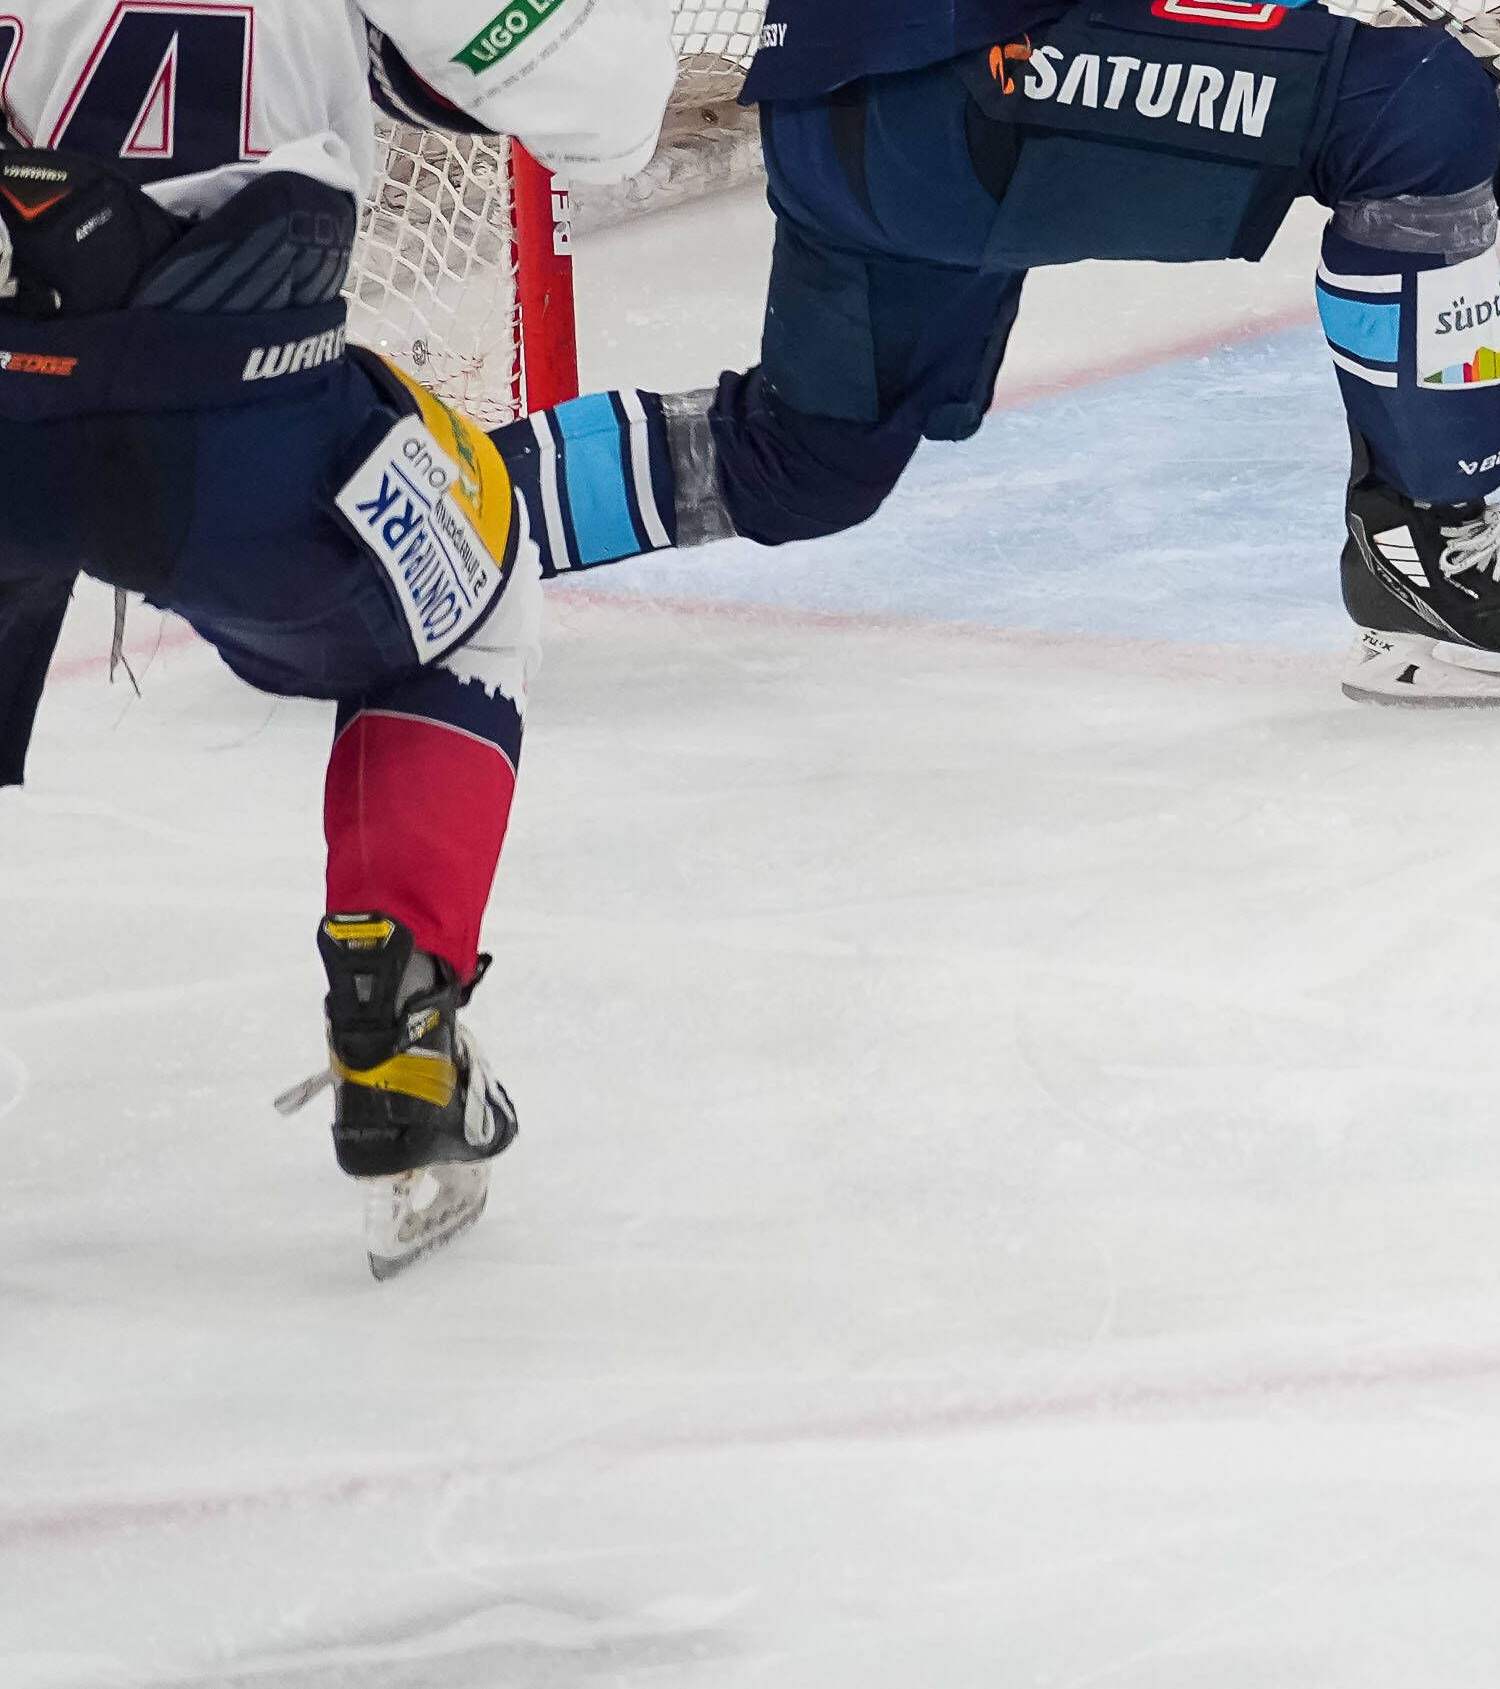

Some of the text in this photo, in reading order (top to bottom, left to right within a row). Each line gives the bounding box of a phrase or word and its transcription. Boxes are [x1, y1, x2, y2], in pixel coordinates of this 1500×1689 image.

[0, 0, 273, 163] 4
[470, 10, 529, 63] LIGO
[1022, 43, 1278, 139] SATURN
